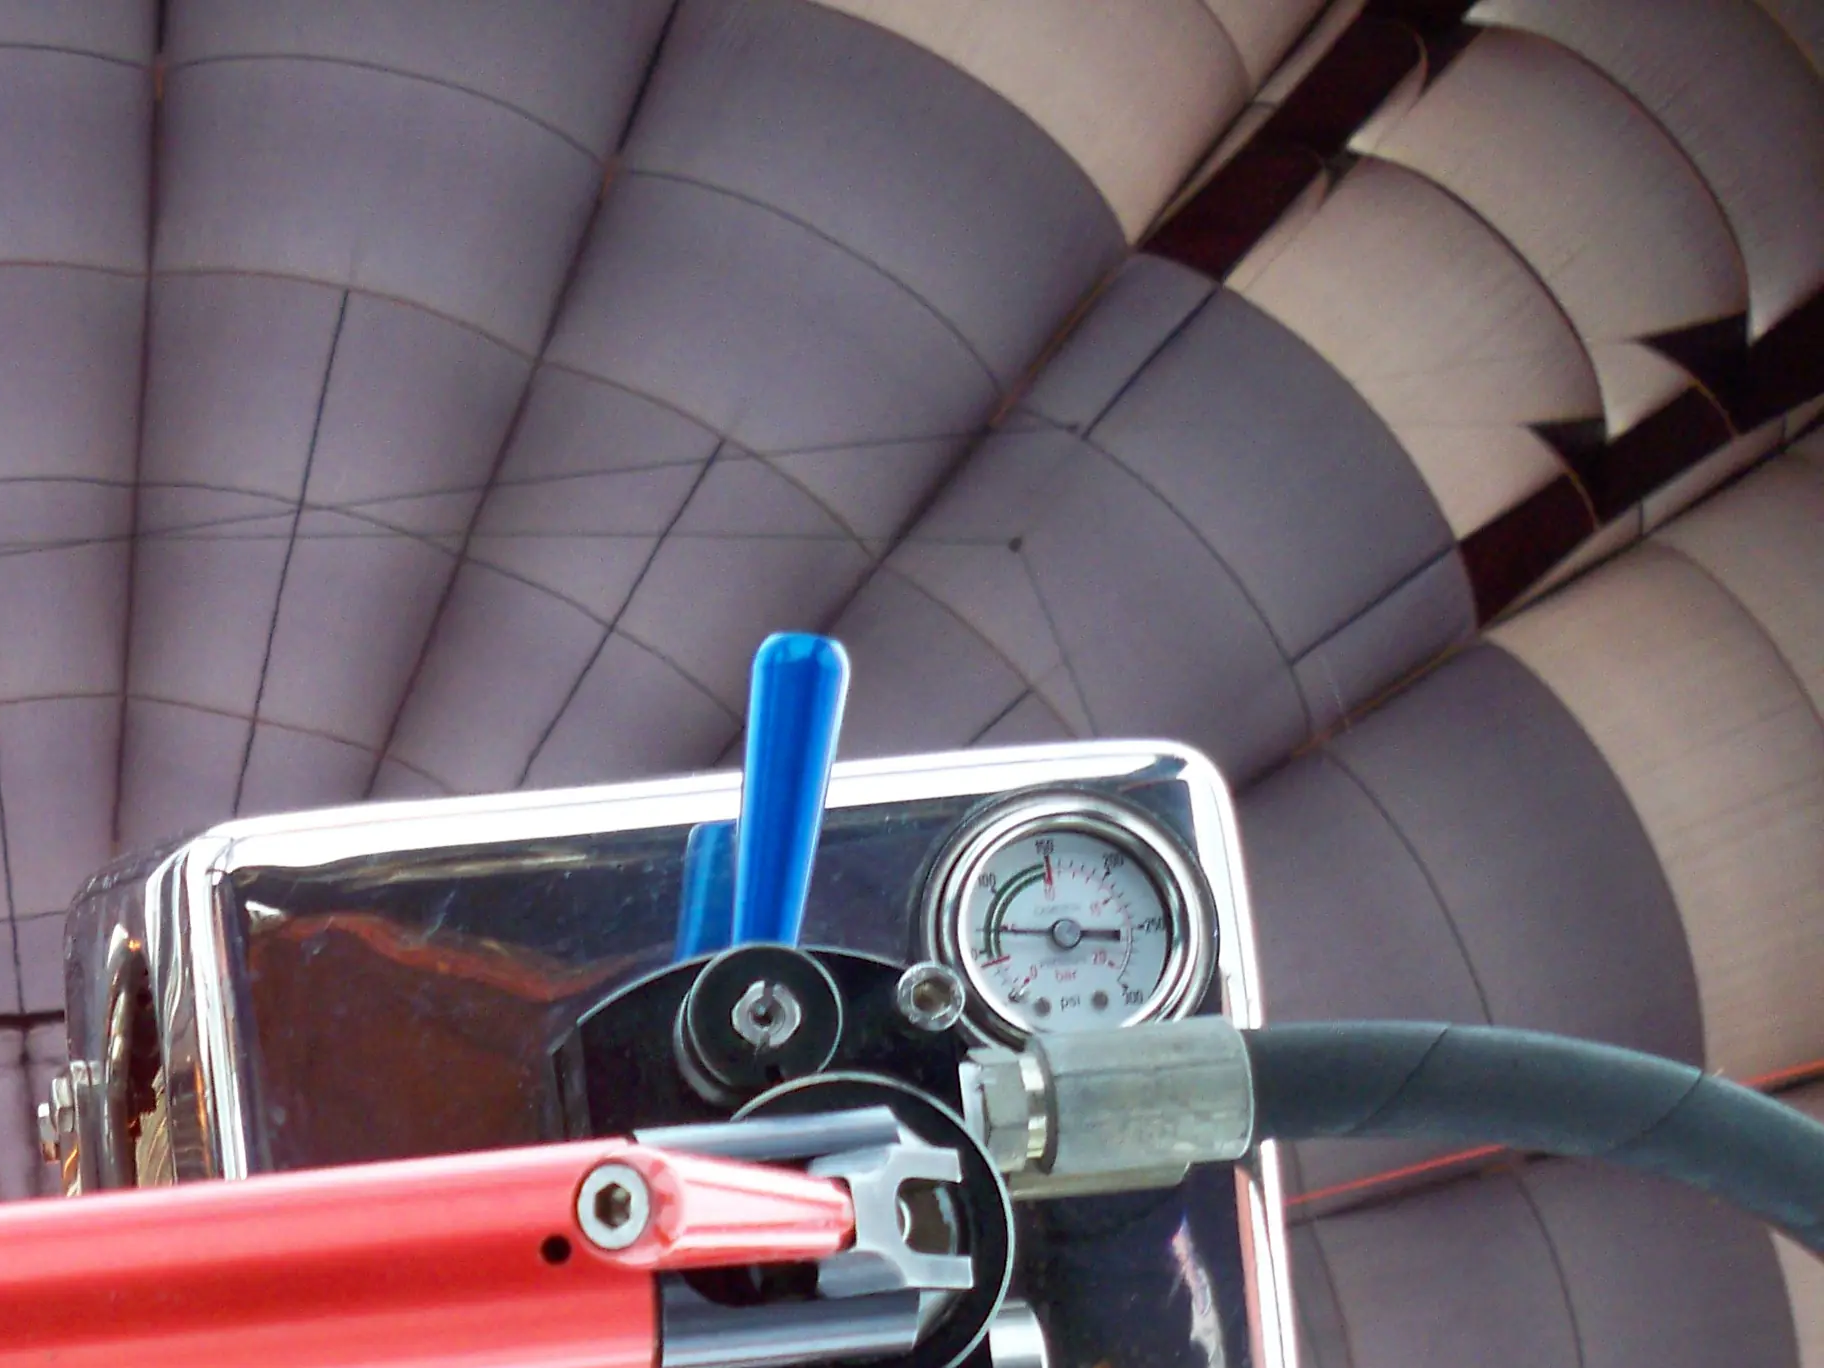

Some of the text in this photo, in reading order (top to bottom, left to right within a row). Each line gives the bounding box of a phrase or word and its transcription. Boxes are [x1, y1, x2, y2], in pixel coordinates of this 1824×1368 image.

[978, 872, 996, 888] 100
[1055, 968, 1077, 983] bar
[1060, 995, 1081, 1012] psi
